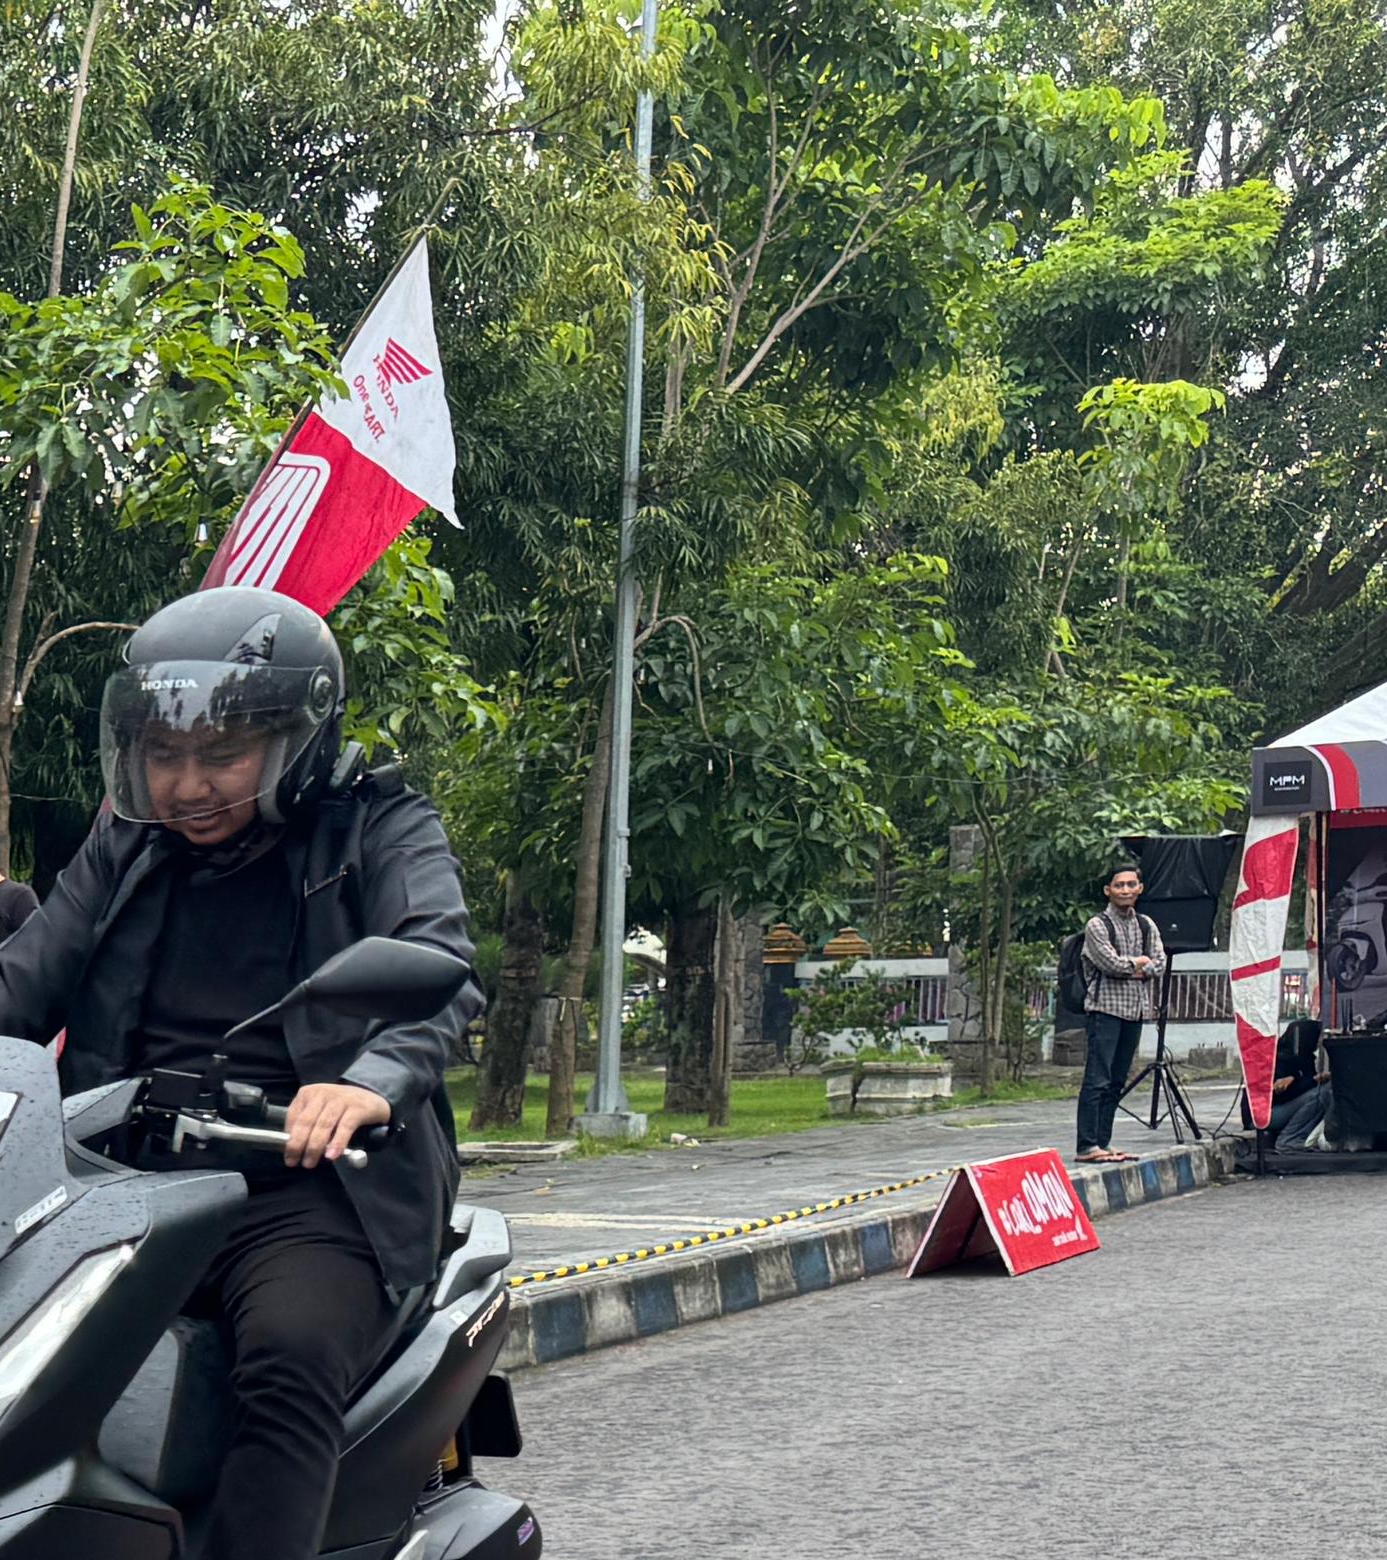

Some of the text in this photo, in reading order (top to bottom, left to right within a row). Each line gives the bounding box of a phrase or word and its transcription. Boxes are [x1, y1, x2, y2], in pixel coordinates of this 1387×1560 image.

[353, 374, 372, 402] One
[140, 678, 199, 691] HONDA
[1269, 774, 1306, 786] MPM
